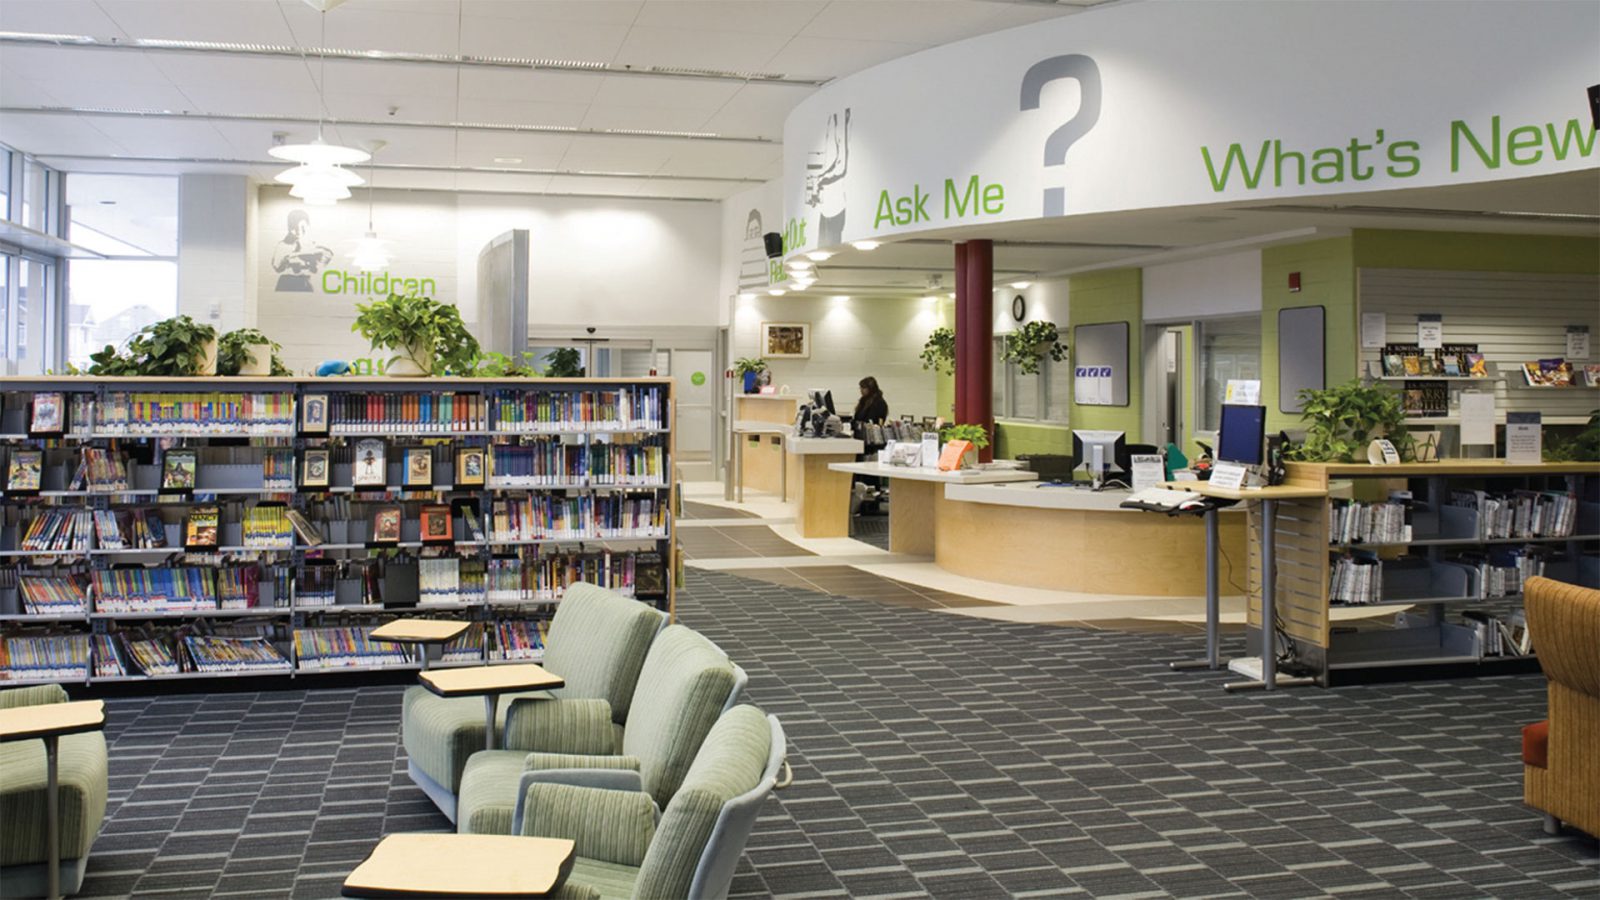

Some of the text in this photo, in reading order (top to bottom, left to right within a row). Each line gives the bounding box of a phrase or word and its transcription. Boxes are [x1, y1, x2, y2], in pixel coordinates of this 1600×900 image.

[1201, 116, 1598, 193] What's New
[874, 175, 1006, 228] Ask Me
[322, 269, 436, 296] Children
